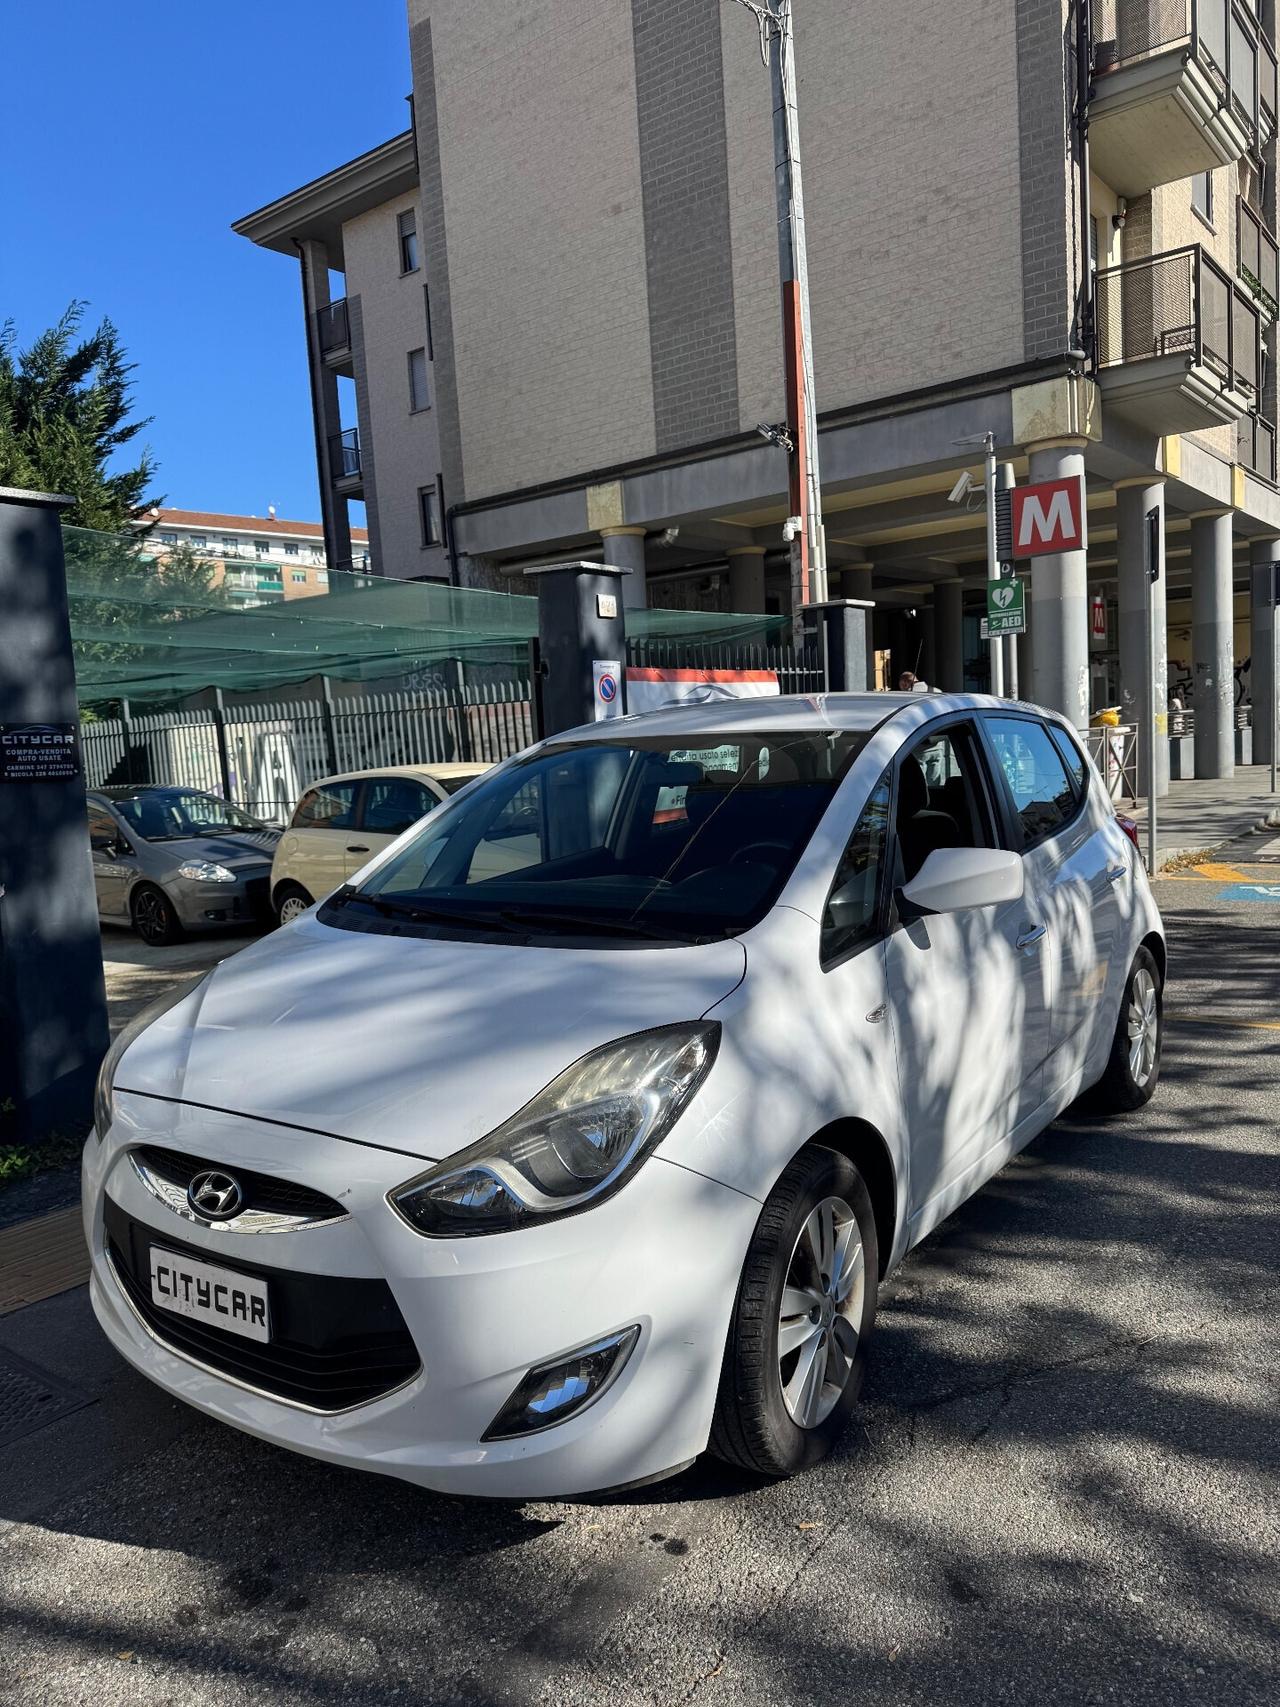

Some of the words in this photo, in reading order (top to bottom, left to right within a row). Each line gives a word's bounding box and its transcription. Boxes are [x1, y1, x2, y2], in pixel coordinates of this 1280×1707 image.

[1018, 490, 1076, 547] M
[1001, 616, 1022, 628] AED
[2, 735, 74, 744] CITYCAR
[699, 751, 719, 760] usato
[157, 1266, 265, 1327] CITYCAR
